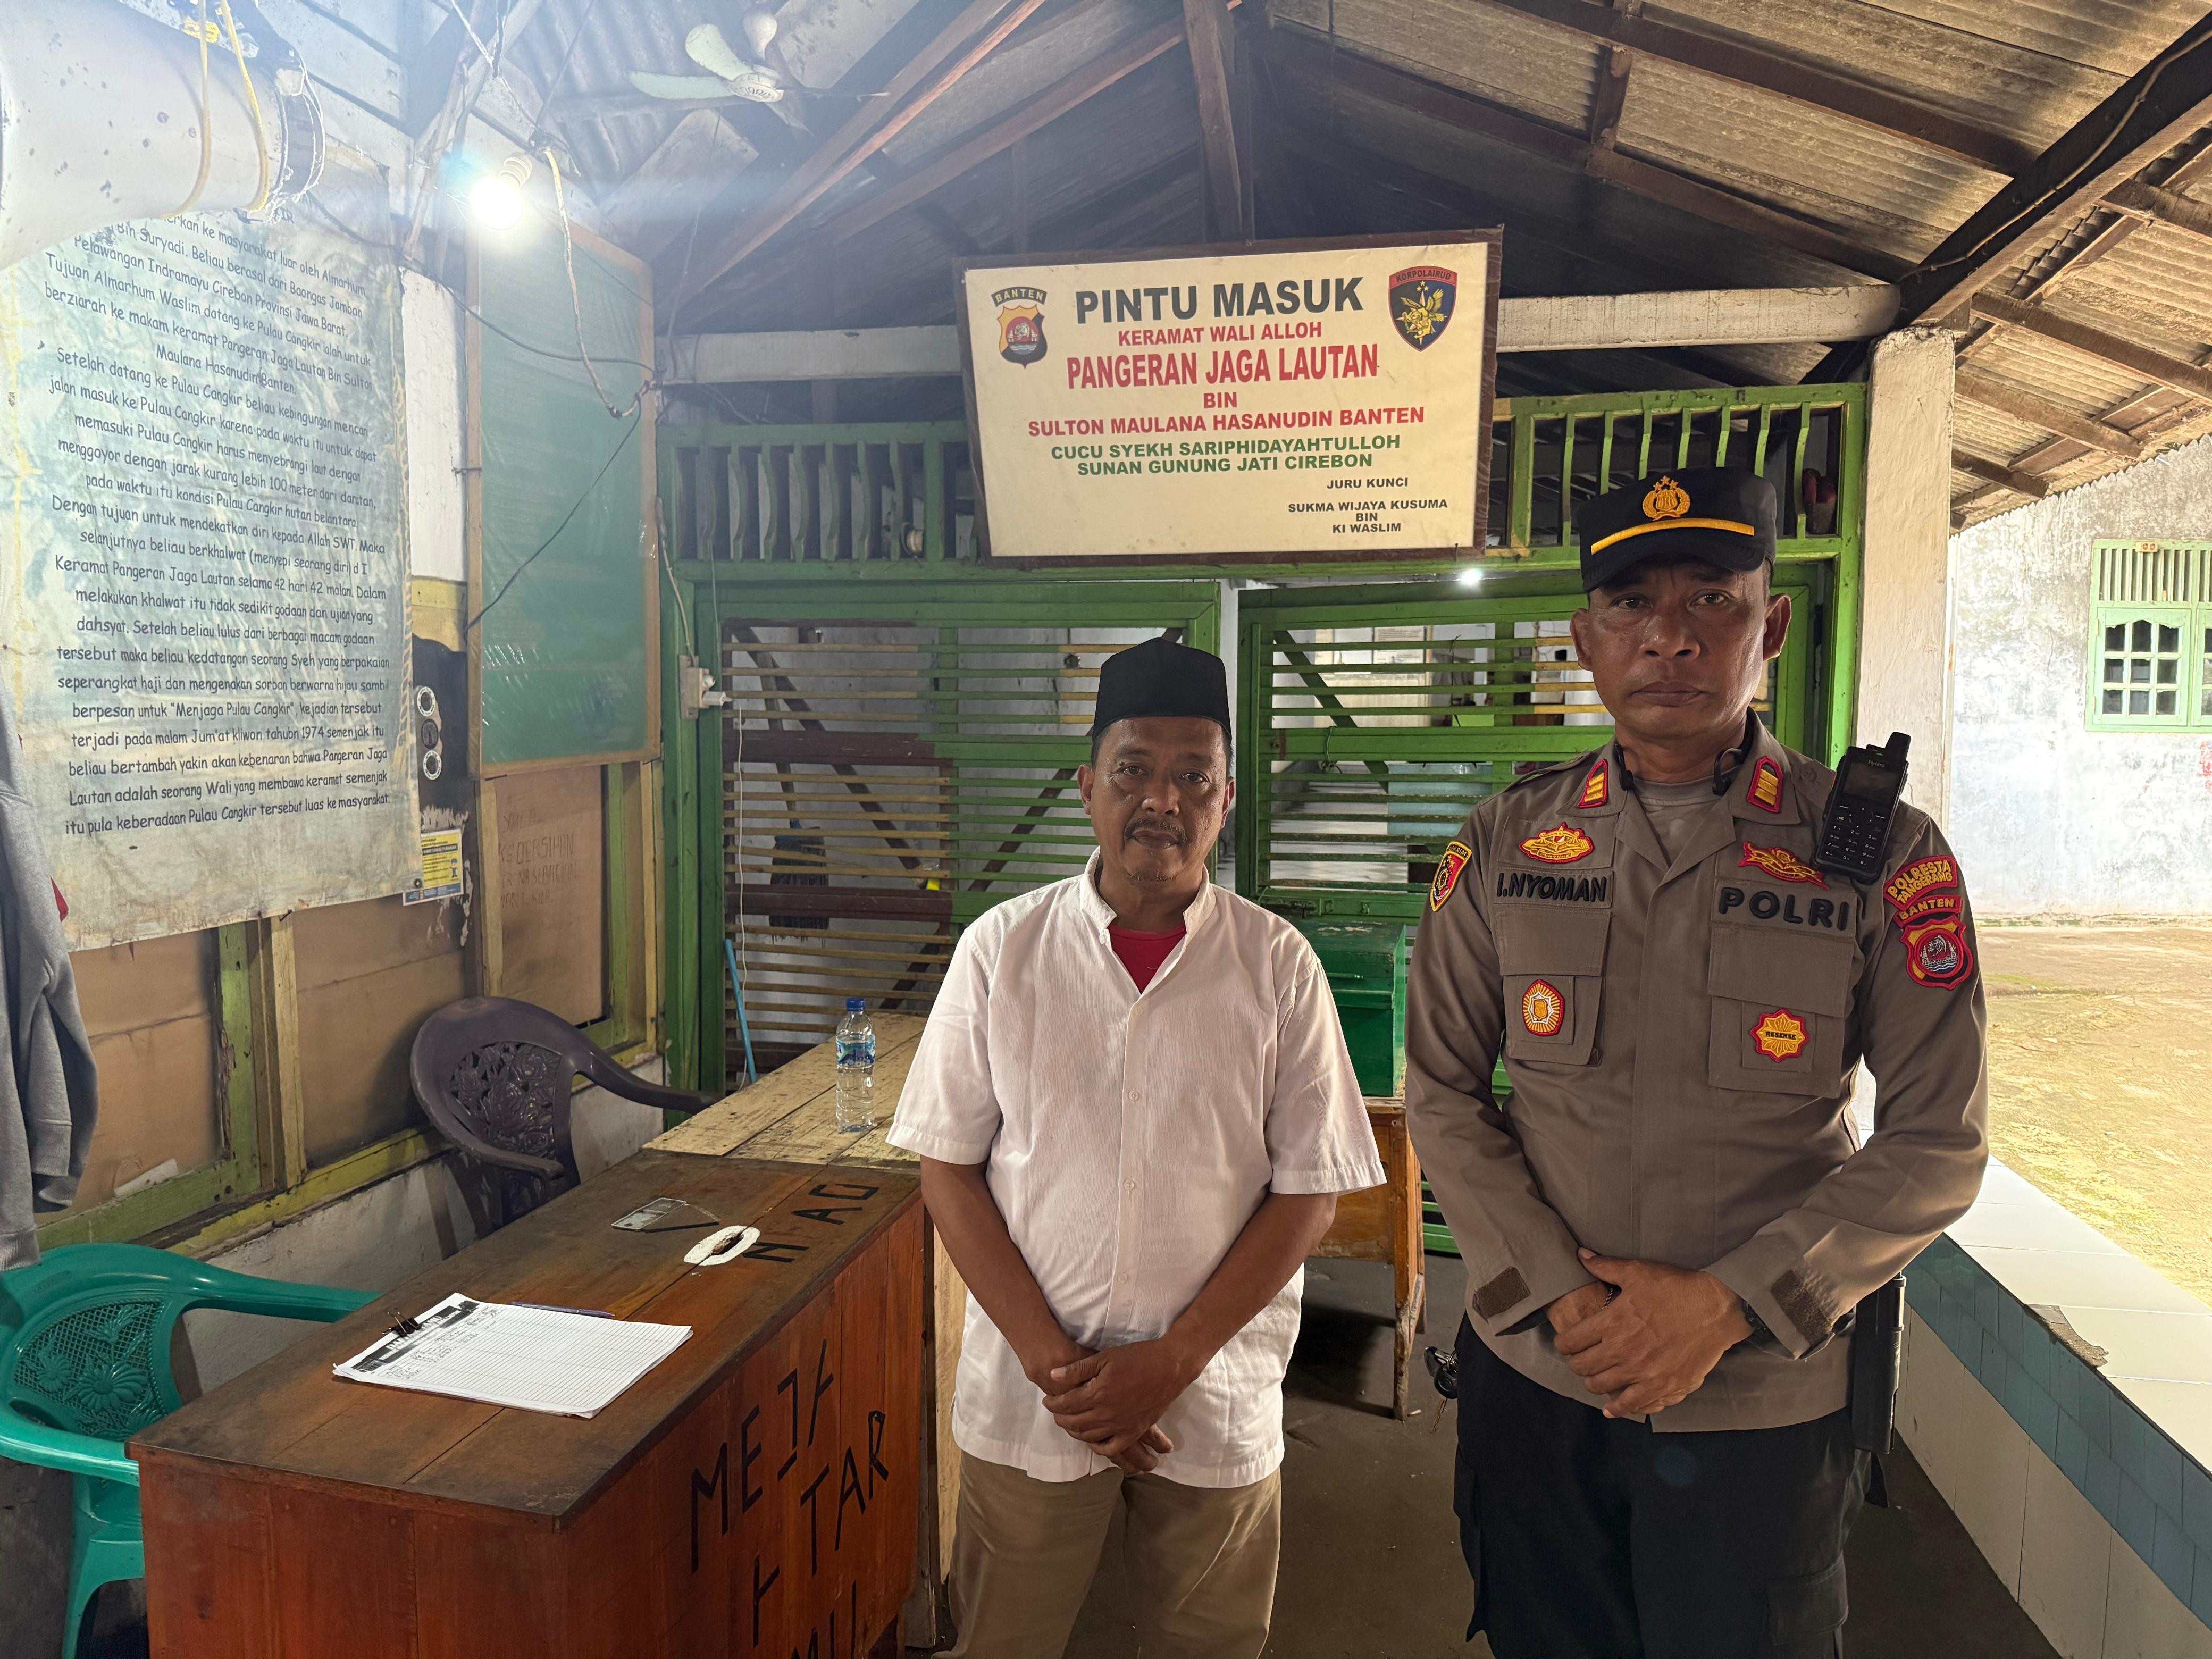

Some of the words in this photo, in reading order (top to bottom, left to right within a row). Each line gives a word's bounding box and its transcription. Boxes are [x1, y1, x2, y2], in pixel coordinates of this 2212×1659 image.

[1396, 270, 1451, 283] KORPOLAIRUD
[46, 252, 89, 281] Tujuan
[95, 271, 155, 300] Almarhum
[160, 289, 200, 315] Waslim
[204, 305, 239, 330] datang
[243, 316, 255, 331] ke
[258, 321, 282, 340] Pulau
[286, 331, 320, 351] Cangkir
[345, 352, 371, 366] untuk
[148, 258, 208, 292] Indramayu
[213, 280, 252, 306] Cirebon
[256, 294, 292, 318] Provinsi
[296, 308, 319, 326] Jawa
[322, 317, 348, 337] Barat.
[995, 289, 1043, 301] BANTEN
[1076, 286, 1197, 324] PINTU
[1213, 276, 1363, 316] MASUK
[1119, 327, 1204, 346] KERAMAT
[1210, 325, 1254, 341] WALI
[1261, 322, 1322, 340] ALLOH
[156, 345, 202, 368] Maulana
[1067, 352, 1197, 389] PANGERAN
[1205, 349, 1271, 383] JAGA
[1279, 344, 1378, 380] LAUTAN
[1203, 392, 1237, 408] BIN
[1028, 419, 1104, 437] SULTON
[1111, 416, 1206, 434] MAULANA
[1213, 410, 1332, 430] HASANUDIN
[1340, 406, 1424, 425] BANTEN
[75, 415, 133, 437] memasuki
[138, 424, 169, 443] Pulau
[173, 432, 212, 453] Cangkir
[217, 440, 245, 458] harus
[248, 450, 307, 474] menyebrangi
[312, 460, 326, 475] laut
[1051, 446, 1102, 459] CUCU
[1110, 443, 1172, 458] SYEKH
[1179, 435, 1400, 456] SARIPHIDAYAHTULLOH
[1078, 462, 1141, 476] SUNAN
[1149, 459, 1230, 474] GUNUNG
[1237, 457, 1277, 471] JATI
[1285, 454, 1372, 470] CIREBON
[1327, 480, 1362, 489] JURU
[1367, 477, 1408, 488] KUNCI
[1288, 503, 1334, 513] SUKMA
[1338, 501, 1386, 511] WIJAYA
[1391, 499, 1447, 509] KUSUMA
[1356, 513, 1378, 522] BIN
[53, 495, 97, 517] Dengan
[102, 504, 138, 523] tujuan
[143, 512, 176, 526] untuk
[180, 516, 248, 535] mendekatkan
[252, 524, 269, 537] diri
[272, 527, 304, 544] kepada
[308, 534, 330, 547] Allah
[359, 540, 385, 554] Maka
[1333, 524, 1345, 533] KI
[1351, 523, 1401, 532] WASLIM
[56, 555, 109, 574] Keramat
[113, 561, 165, 581] Pangeran
[170, 567, 197, 586] Jaga
[201, 570, 234, 585] Lautan
[239, 574, 272, 589] selama
[275, 579, 285, 590] 42
[311, 582, 323, 593] 42
[357, 586, 386, 599] Dalam
[76, 587, 137, 605] melakukan
[141, 592, 185, 608] khalwat
[190, 597, 206, 610] itu
[210, 598, 236, 611] tidak
[238, 601, 273, 614] sedikit
[276, 604, 306, 619] godaan
[310, 607, 327, 618] dan
[73, 703, 134, 722] berpesan
[138, 703, 167, 718] untuk
[227, 702, 250, 716] Pulau
[341, 702, 382, 714] tersebut
[125, 731, 153, 749] pada
[155, 730, 187, 744] malam
[302, 726, 324, 739] 1974
[328, 725, 370, 739] semenjak
[372, 726, 384, 736] itu
[69, 760, 106, 776] beliau
[111, 757, 177, 774] bertambah
[180, 756, 207, 774] yakin
[212, 755, 236, 767] akan
[239, 753, 290, 768] kebenaran
[293, 751, 320, 763] bahwa
[324, 750, 364, 764] Pangeran
[367, 748, 387, 763] Jaga
[1868, 759, 1884, 768] Hytera
[70, 791, 111, 806] Lautan
[115, 785, 157, 801] adalah
[162, 785, 202, 800] seorang
[206, 780, 231, 794] Wali
[234, 780, 255, 796] yang
[258, 777, 304, 791] membawa
[306, 773, 342, 786] keramat
[346, 770, 387, 785] semenjak
[66, 821, 84, 834] itu
[88, 817, 112, 836] pula
[117, 812, 186, 830] keberadaan
[189, 808, 217, 822] Pulau
[222, 805, 256, 822] Cangkir
[261, 802, 302, 815] tersebut
[305, 798, 323, 811] luas
[328, 797, 337, 809] ke
[1497, 873, 1607, 902] I.NYOMAN
[1888, 860, 1951, 898] POLRESTA
[1897, 872, 1953, 903] TANGERANG
[1718, 885, 1850, 932] POLRI
[1899, 899, 1954, 919] BANTEN
